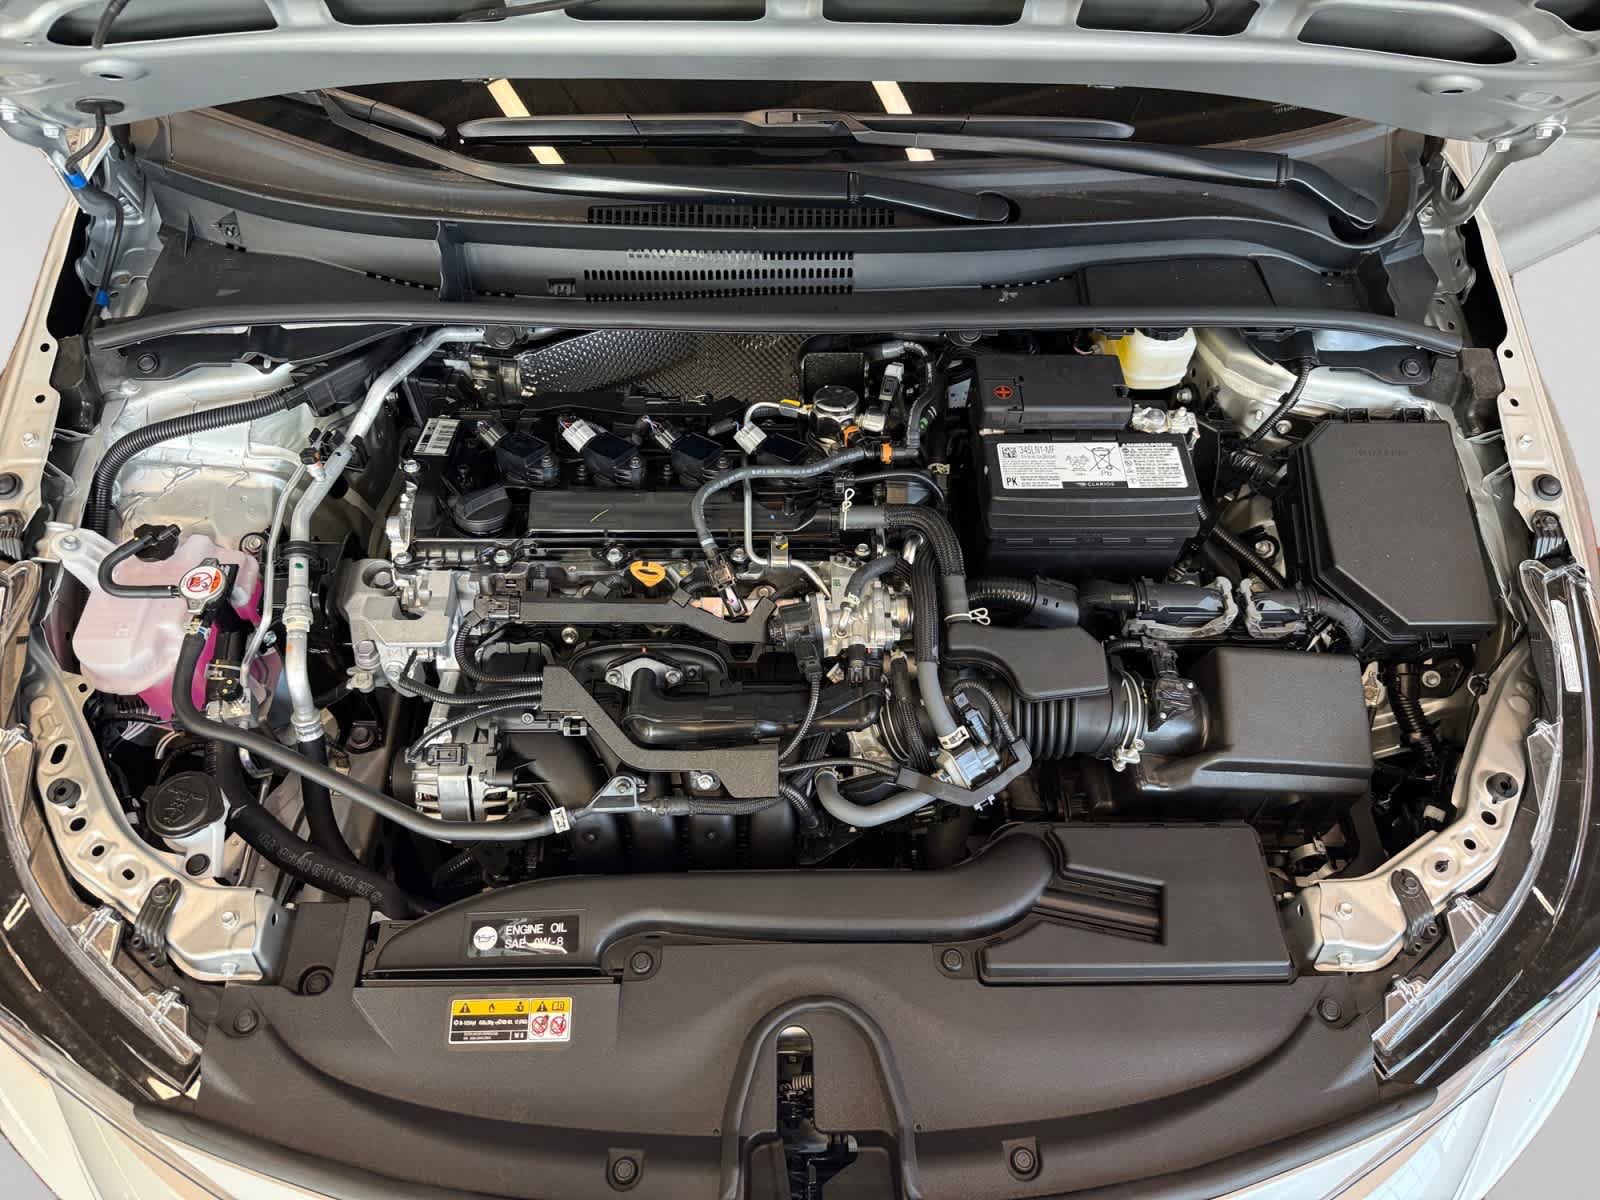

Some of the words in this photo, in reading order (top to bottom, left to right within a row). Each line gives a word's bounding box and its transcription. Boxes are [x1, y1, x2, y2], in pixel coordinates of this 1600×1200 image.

[1006, 477, 1018, 486] PK
[505, 924, 544, 936] ENGINE
[550, 922, 568, 933] OIL
